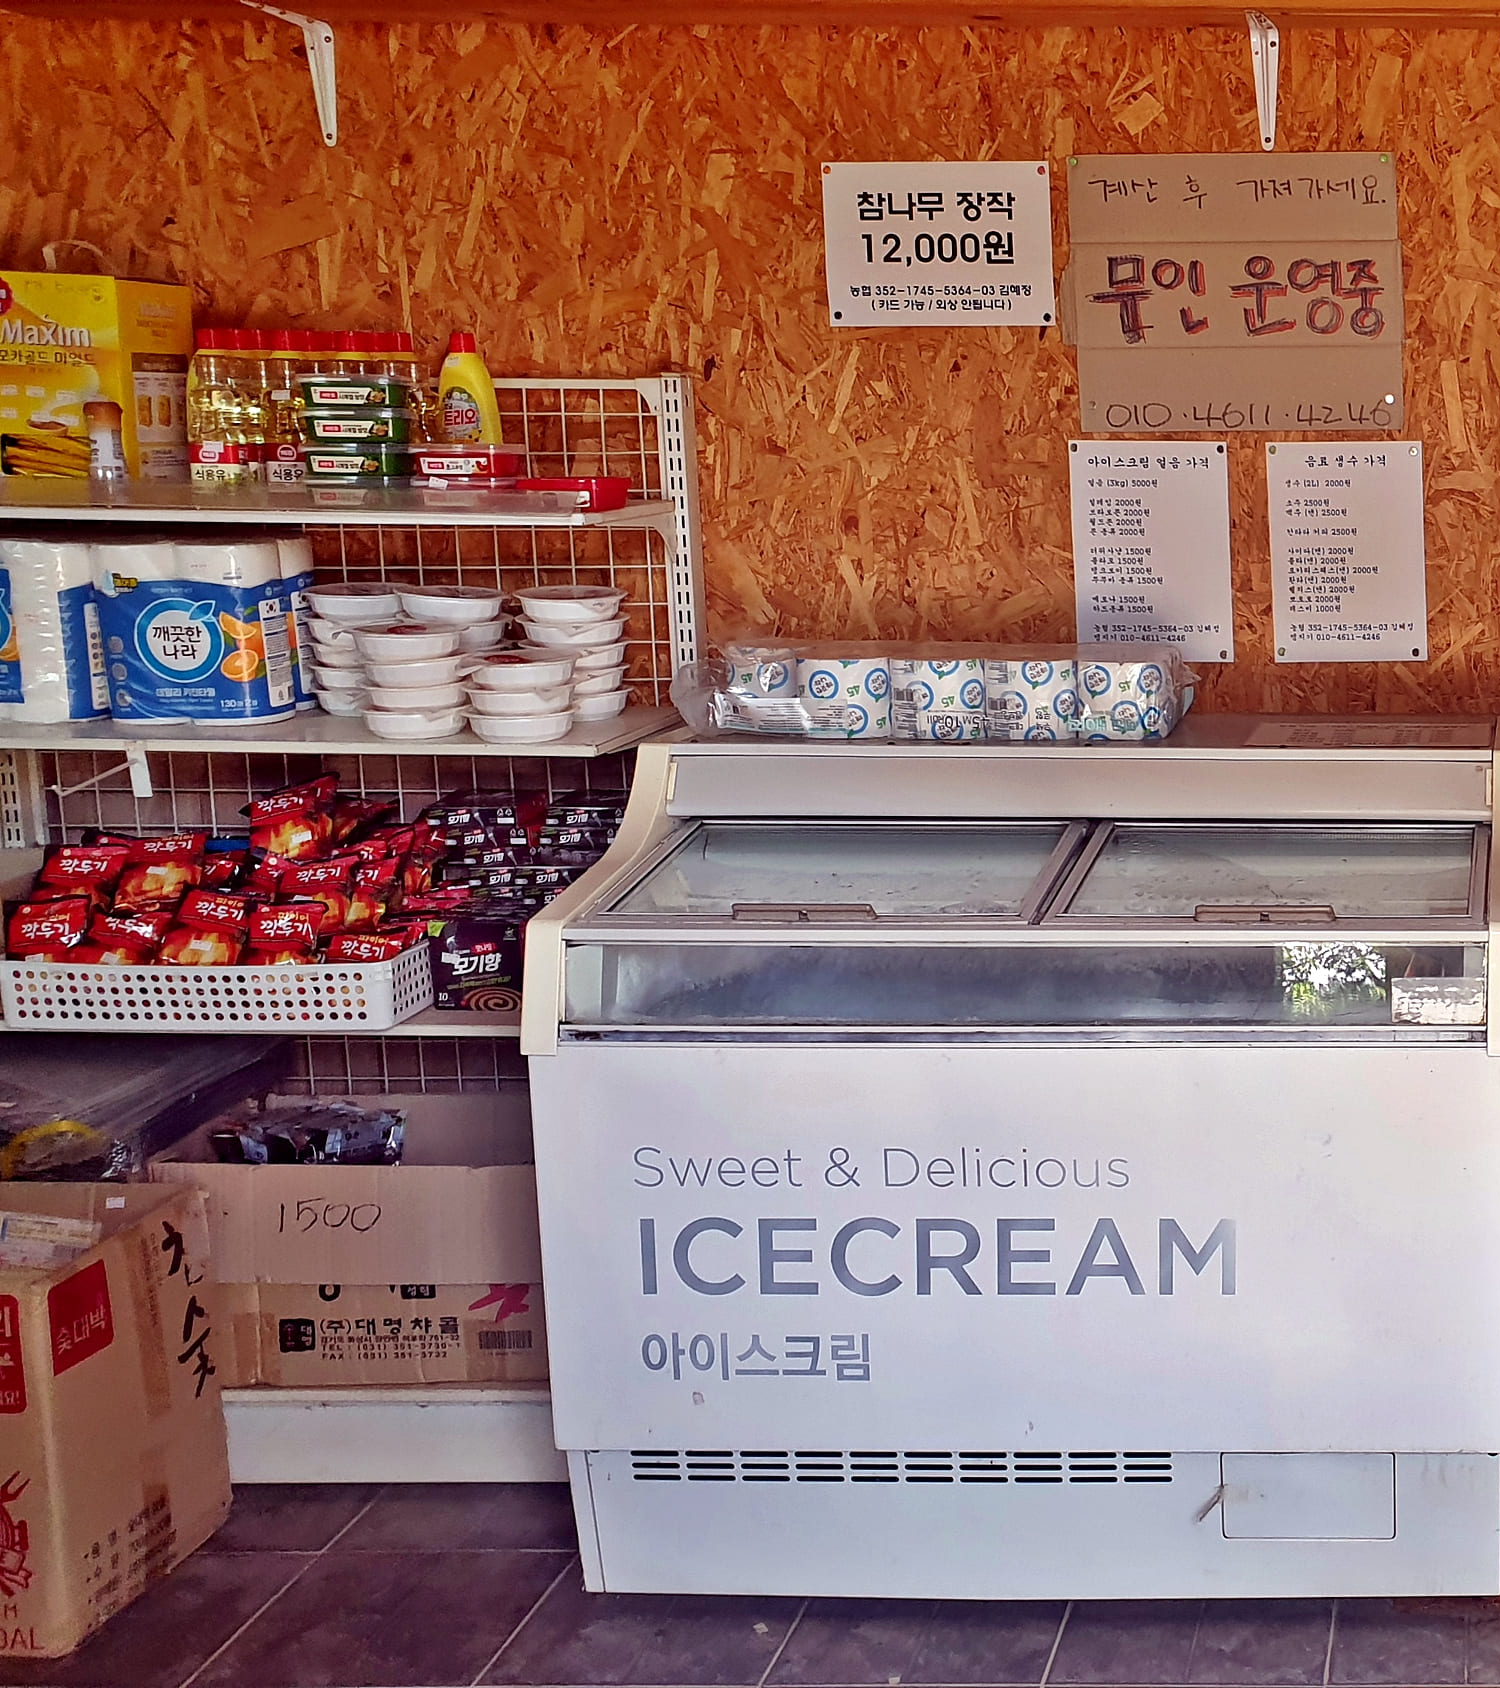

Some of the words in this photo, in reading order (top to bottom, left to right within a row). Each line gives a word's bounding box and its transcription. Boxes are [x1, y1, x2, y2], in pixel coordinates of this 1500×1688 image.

[1088, 177, 1158, 203] 계산
[1183, 175, 1207, 209] 후
[857, 191, 945, 221] 참나무
[956, 192, 1016, 221] 장작
[861, 230, 1015, 267] 12,000원
[850, 285, 872, 297] 농협
[875, 285, 996, 296] 352-1745-5364-03
[1085, 254, 1209, 344] 무인
[1229, 255, 1386, 340] 운영중
[904, 300, 925, 311] 가능
[935, 300, 957, 311] 외상
[1, 313, 92, 347] Maxim
[444, 409, 477, 426] 트리오
[1088, 456, 1149, 469] 아이스크림
[1156, 457, 1180, 469] 얼음
[1186, 457, 1209, 469] 가격
[1305, 455, 1329, 468] 음료
[1336, 455, 1358, 468] 생수
[1364, 454, 1386, 467] 가격
[152, 625, 202, 643] 깨끗한
[1112, 625, 1193, 633] 352-1745-5364-03
[1308, 623, 1388, 632] 352-1745-5364-03
[1316, 633, 1381, 641] 010-4611-4246
[1120, 634, 1186, 642] 010-4611-4246
[163, 644, 198, 660] 나라
[452, 953, 502, 975] 모기향
[633, 1146, 802, 1189] Sweet
[824, 1147, 860, 1189] &
[882, 1146, 1131, 1189] Delicious
[278, 1198, 382, 1234] 1500
[639, 1217, 1237, 1298] ICECREAM
[56, 1304, 106, 1355] 숯대박
[641, 1332, 872, 1382] 아이스크림
